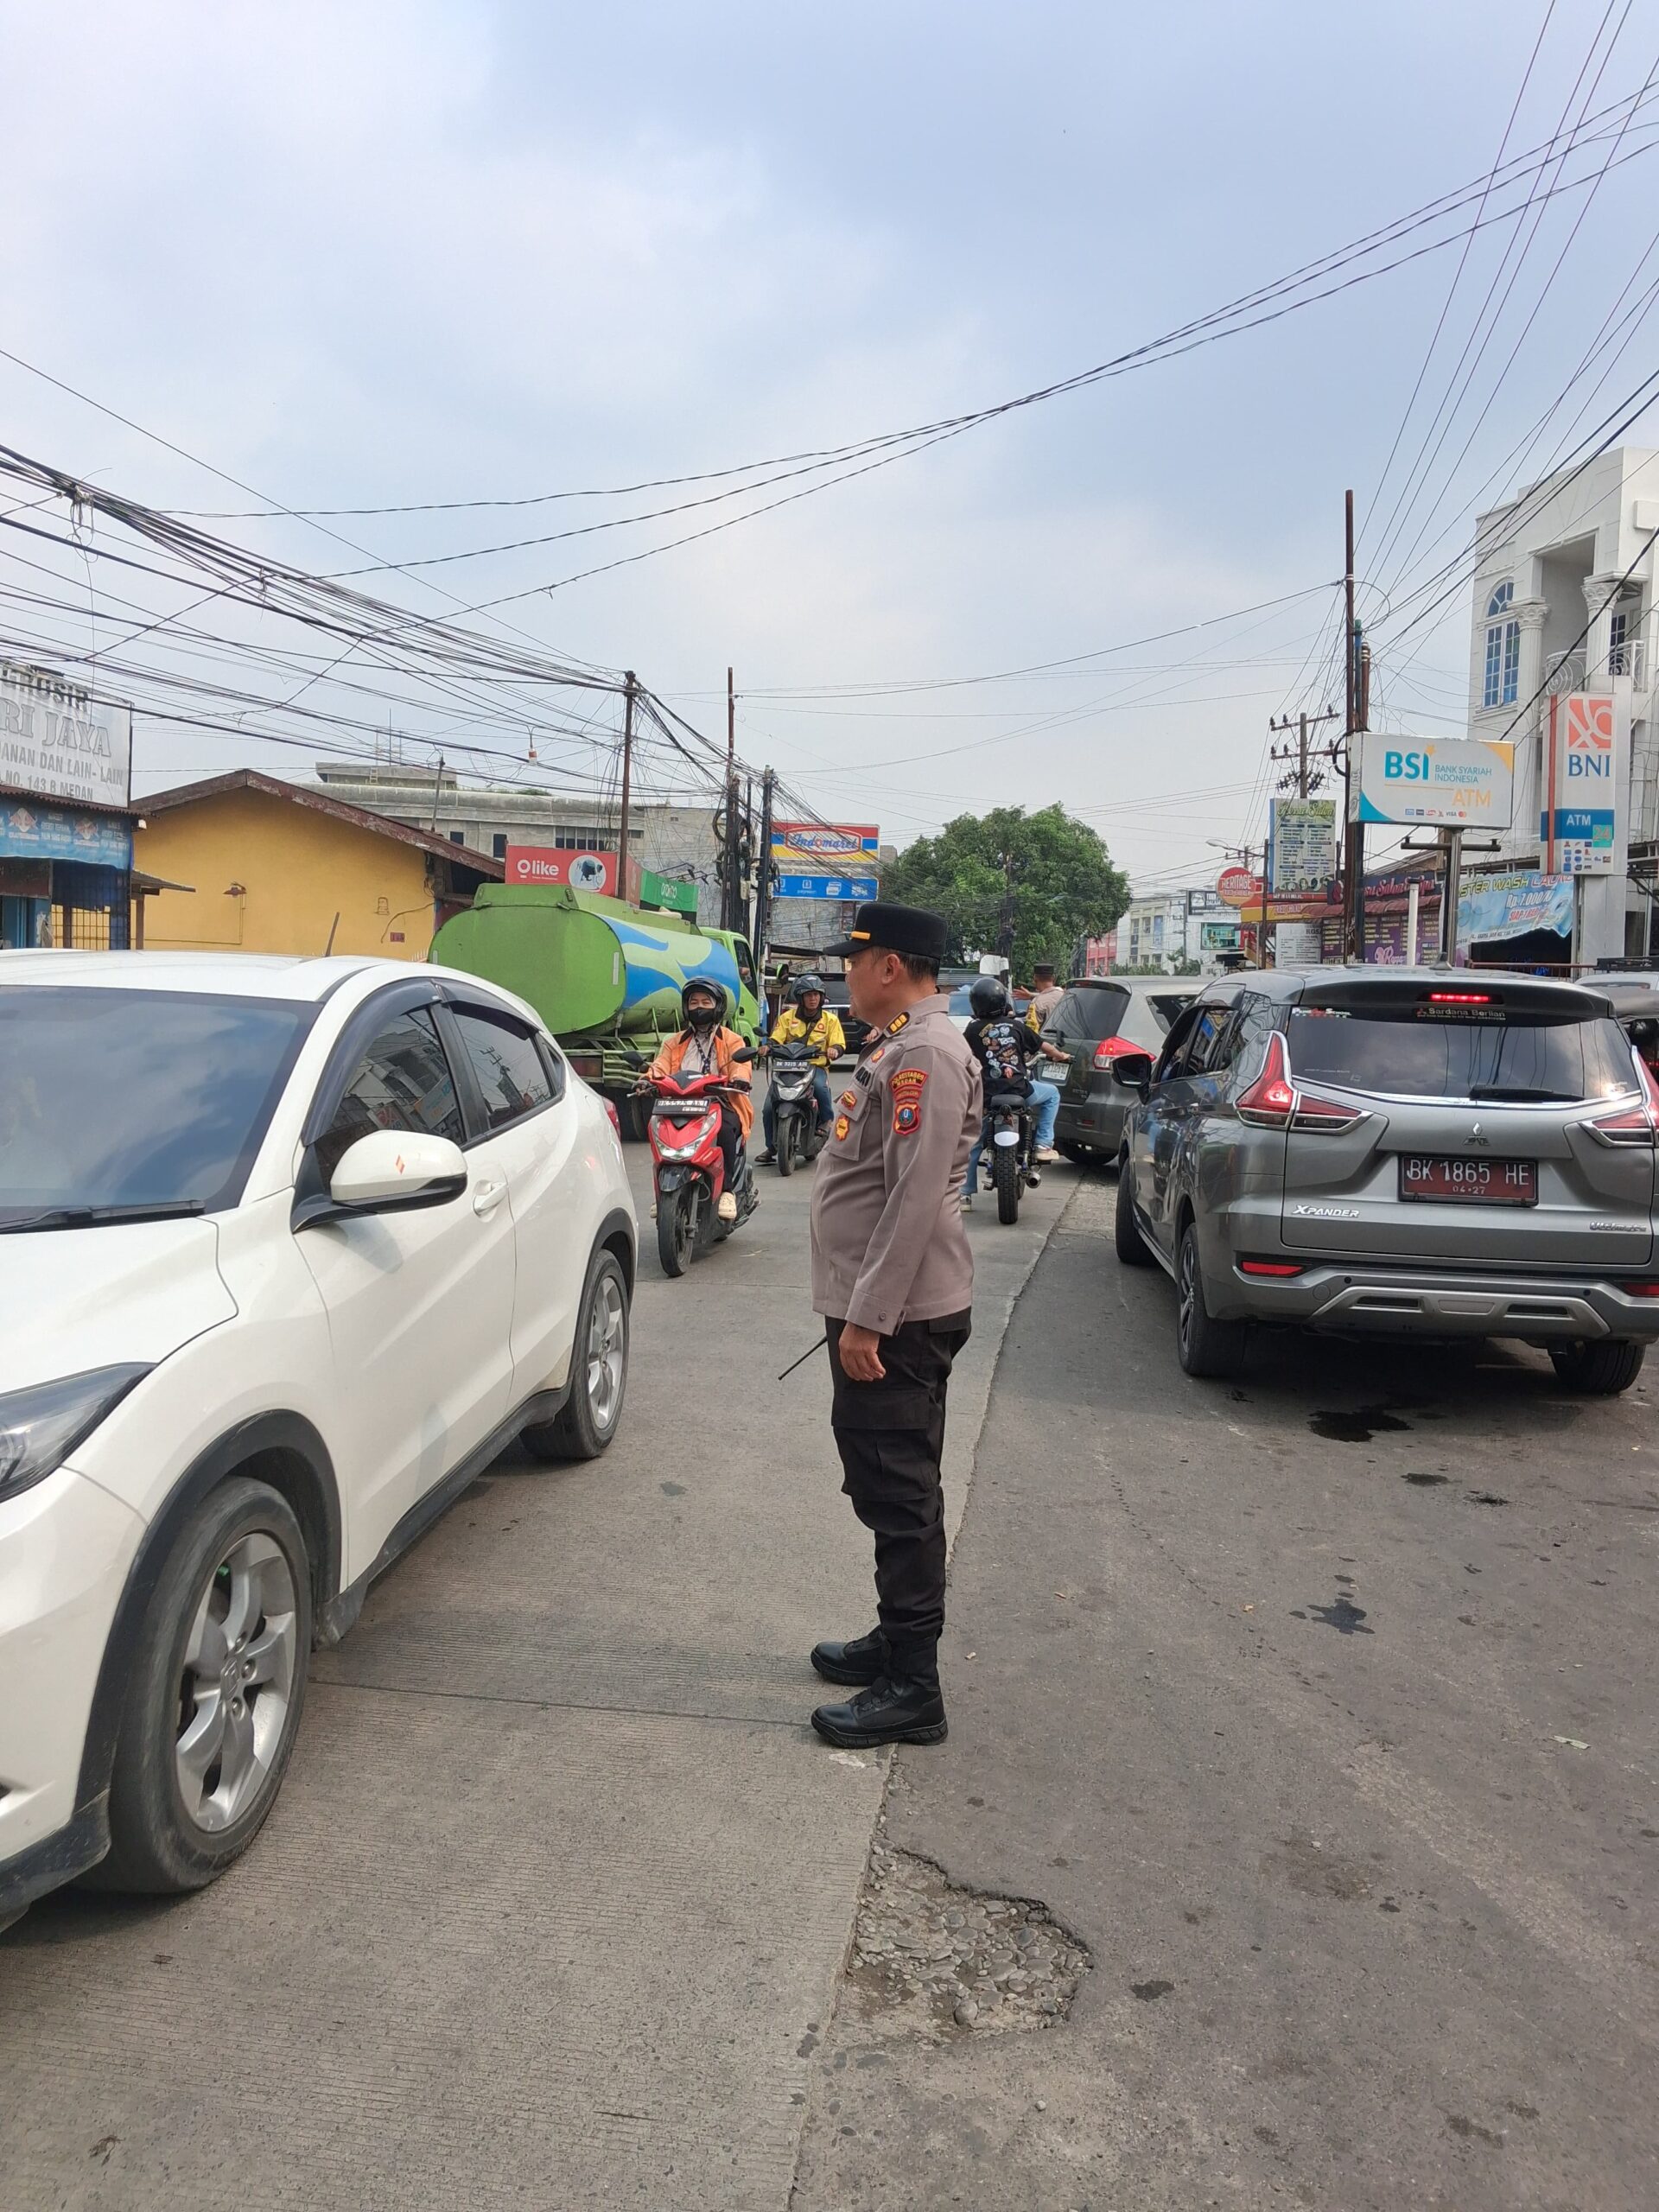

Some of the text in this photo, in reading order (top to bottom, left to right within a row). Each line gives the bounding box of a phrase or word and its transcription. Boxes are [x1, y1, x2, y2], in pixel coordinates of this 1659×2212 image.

[42, 712, 111, 757] JAYA
[40, 752, 63, 773] DAN
[100, 766, 124, 785] LAIN
[1385, 751, 1430, 780] BSI
[1434, 765, 1492, 776] BANK SYARIAH
[1568, 754, 1611, 777] BNI
[28, 775, 47, 791] 143
[60, 781, 93, 801] MEDAN
[1434, 773, 1478, 784] INDONESIA
[1452, 788, 1491, 807] ATM
[1567, 815, 1591, 826] ATM
[791, 833, 858, 850] Indomaret
[1594, 826, 1611, 841] 24
[1221, 874, 1252, 890] HERITAGE
[1459, 880, 1490, 898] STER
[1492, 876, 1529, 891] WASH
[1407, 1160, 1529, 1185] BK 1865 HE
[1292, 1205, 1360, 1217] XPANDER
